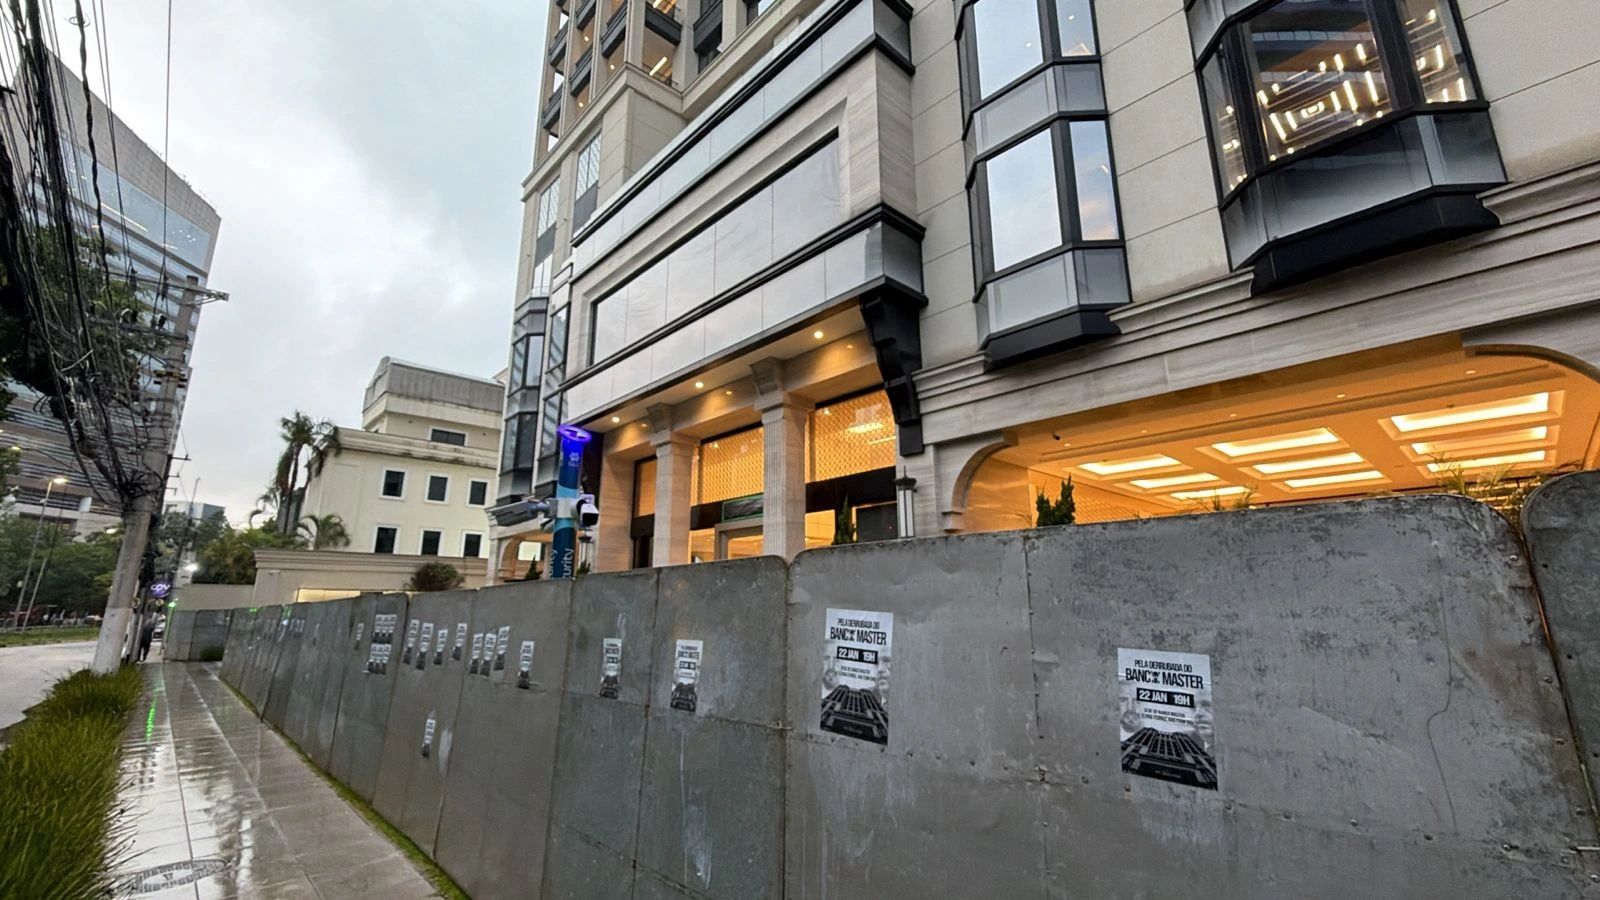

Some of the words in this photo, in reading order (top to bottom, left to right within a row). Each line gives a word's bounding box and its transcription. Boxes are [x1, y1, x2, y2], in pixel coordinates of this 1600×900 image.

[563, 547, 574, 578] urity
[857, 629, 887, 646] MASTER
[839, 648, 847, 658] 22
[847, 649, 860, 660] JAN
[1134, 659, 1149, 668] PELA
[1149, 661, 1183, 672] DERRUBADA
[1183, 664, 1192, 673] DO
[1162, 672, 1204, 689] MASTER
[1139, 690, 1150, 700] 22
[1151, 691, 1168, 703] JAN
[1173, 695, 1190, 706] 19H
